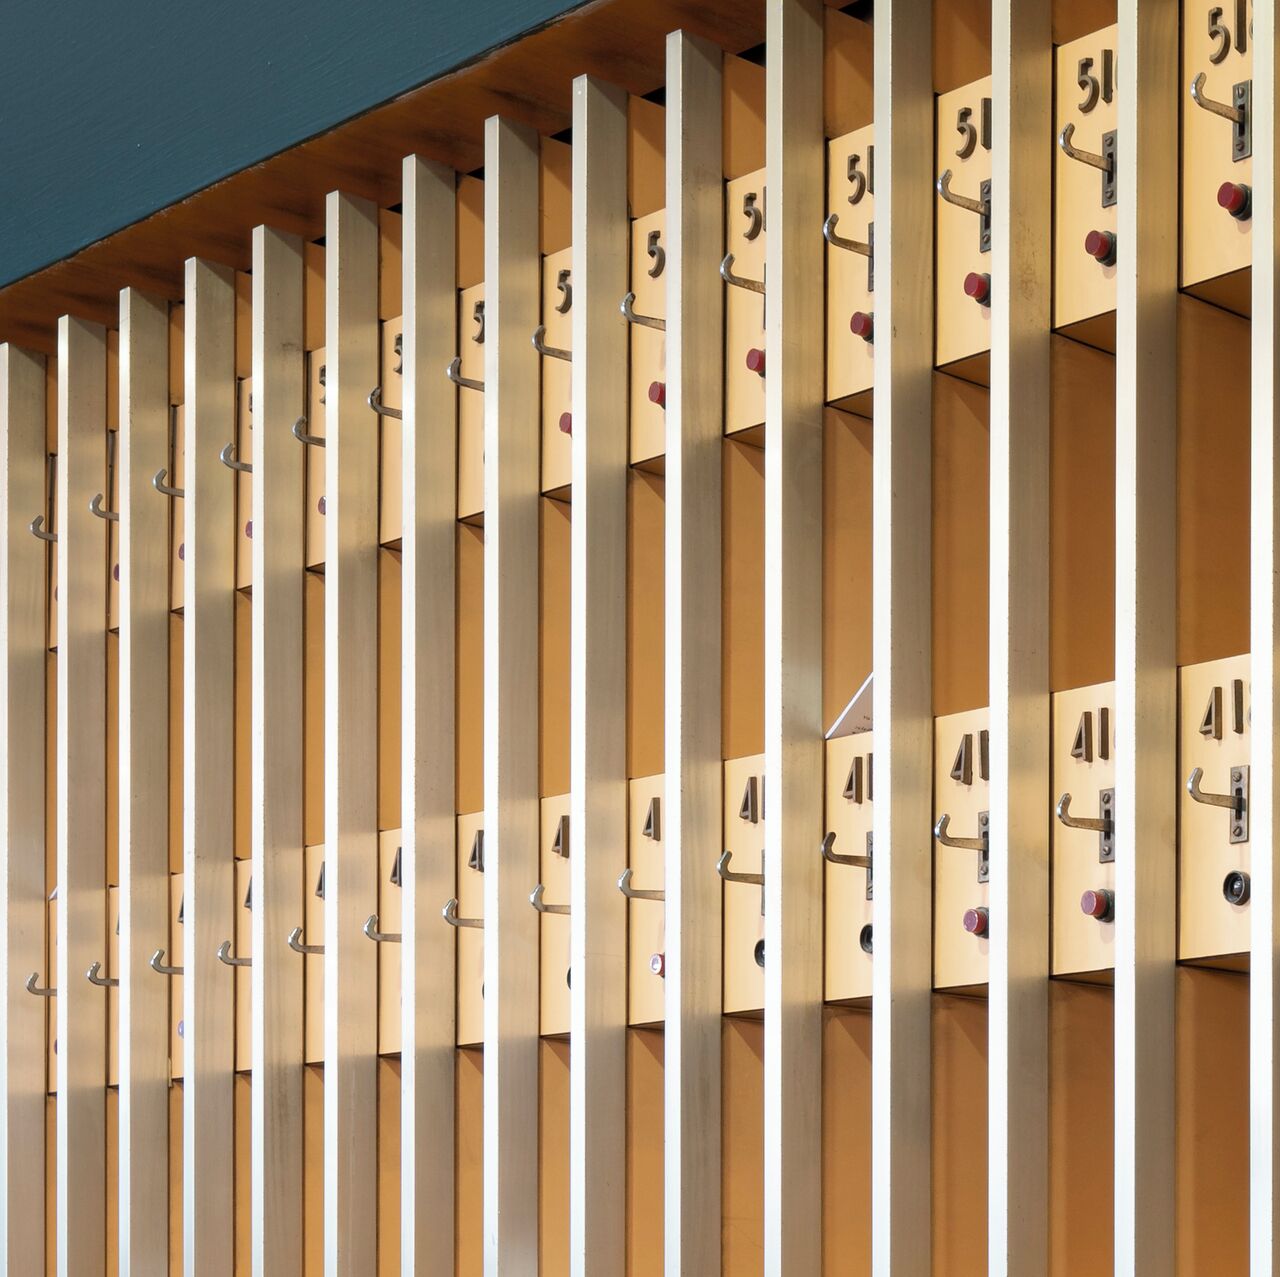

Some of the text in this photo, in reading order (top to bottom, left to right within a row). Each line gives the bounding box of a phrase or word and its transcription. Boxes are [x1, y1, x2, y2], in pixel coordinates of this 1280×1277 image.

[1207, 0, 1253, 65] 51
[1077, 49, 1117, 114] 51
[954, 98, 992, 160] 51
[847, 145, 874, 205] 51
[1070, 707, 1115, 764] 41
[1199, 679, 1251, 740] 41
[842, 753, 873, 805] 41
[950, 730, 989, 786] 41
